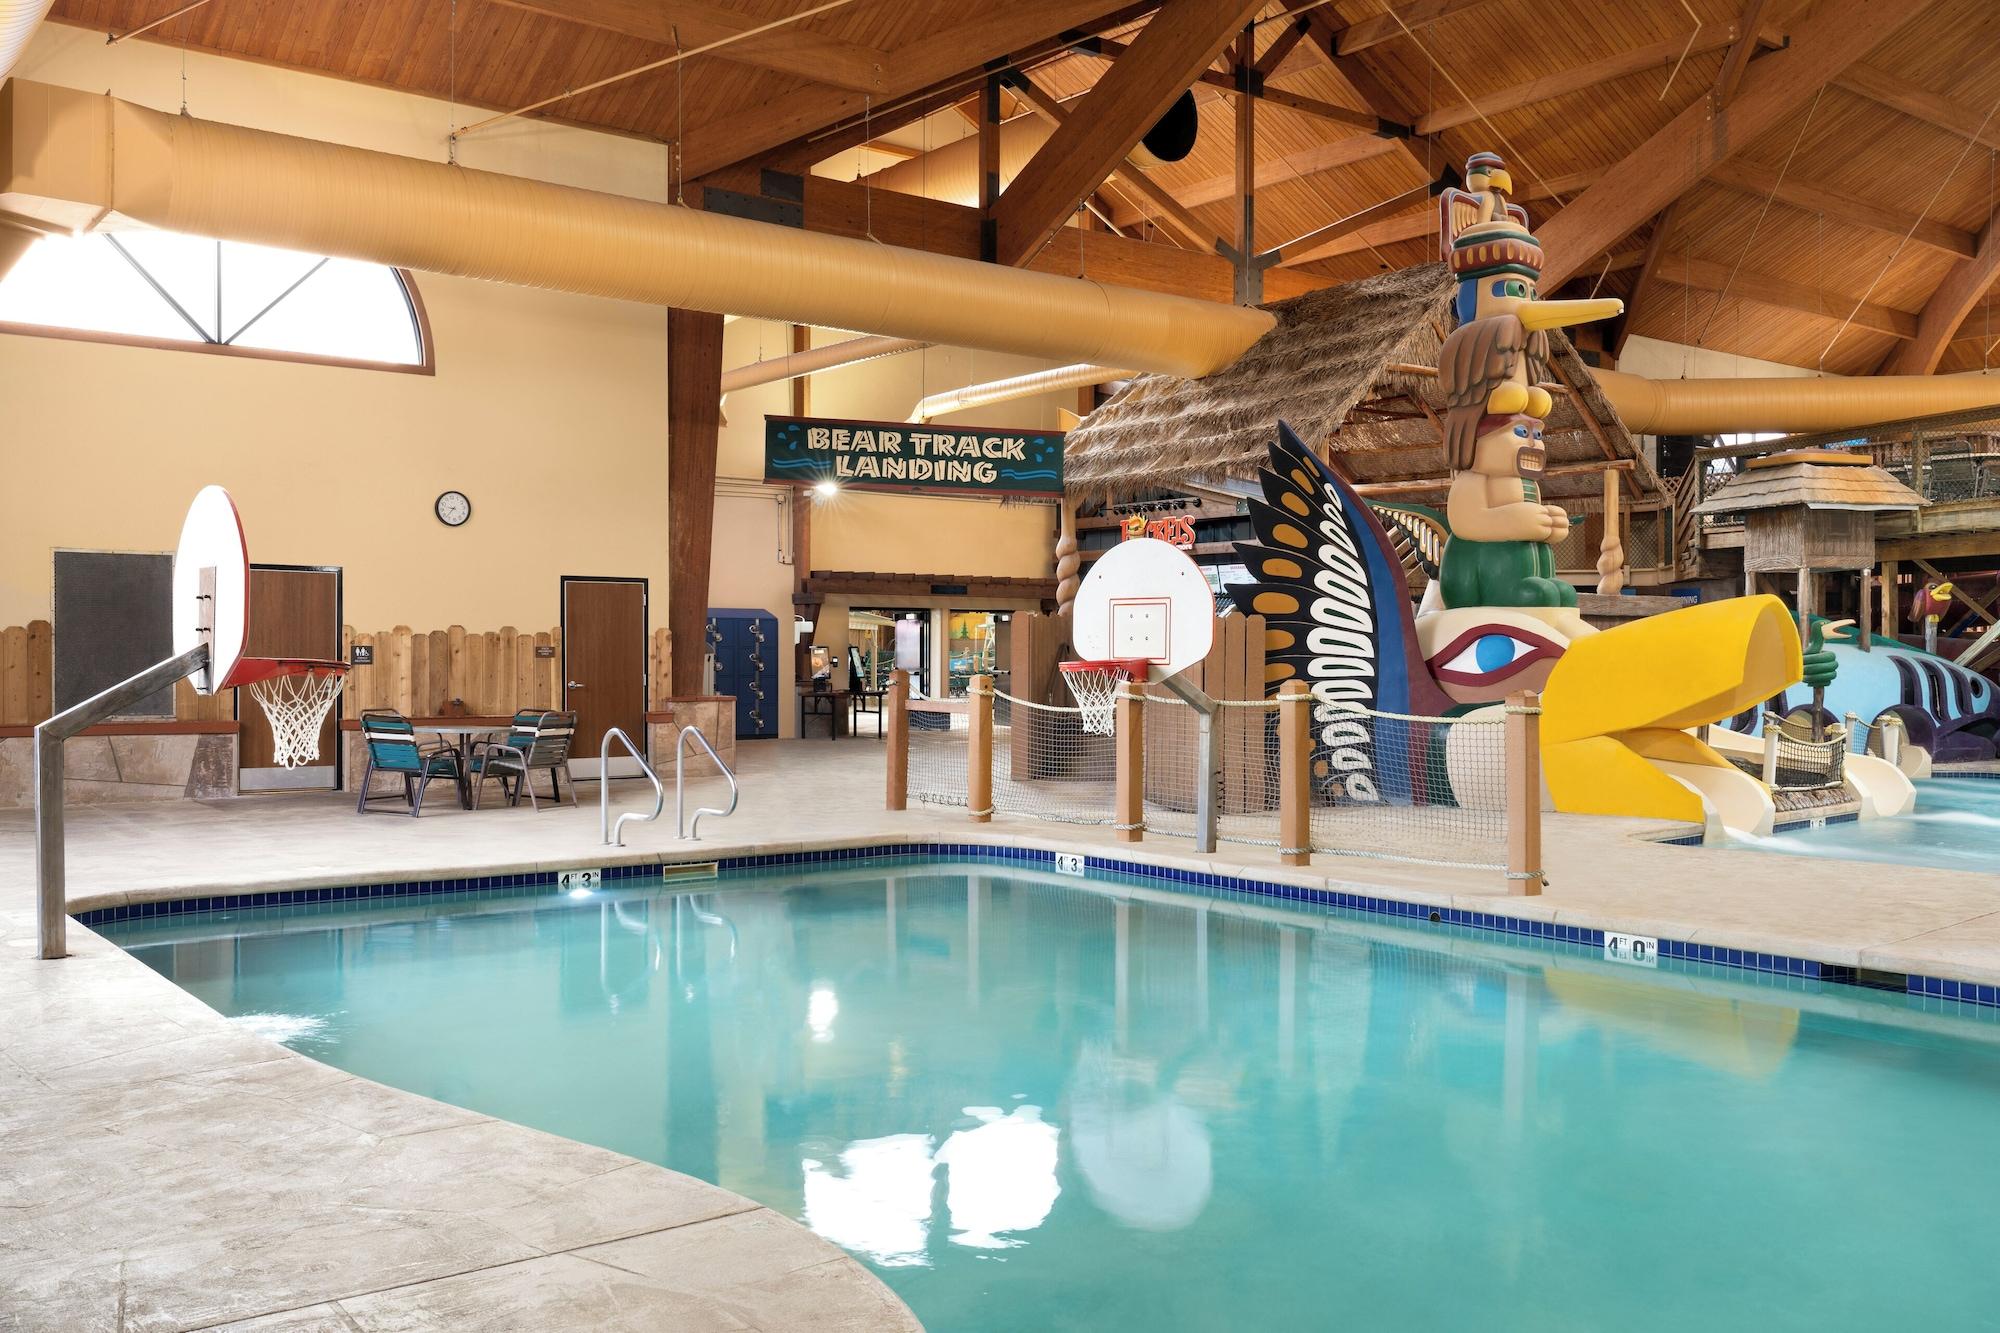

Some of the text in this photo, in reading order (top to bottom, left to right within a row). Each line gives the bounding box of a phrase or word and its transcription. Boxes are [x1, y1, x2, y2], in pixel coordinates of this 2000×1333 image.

[807, 427, 1027, 461] BEAR TRACK
[835, 455, 998, 484] LANDING
[1619, 937, 1628, 945] FT
[1646, 941, 1655, 950] IN
